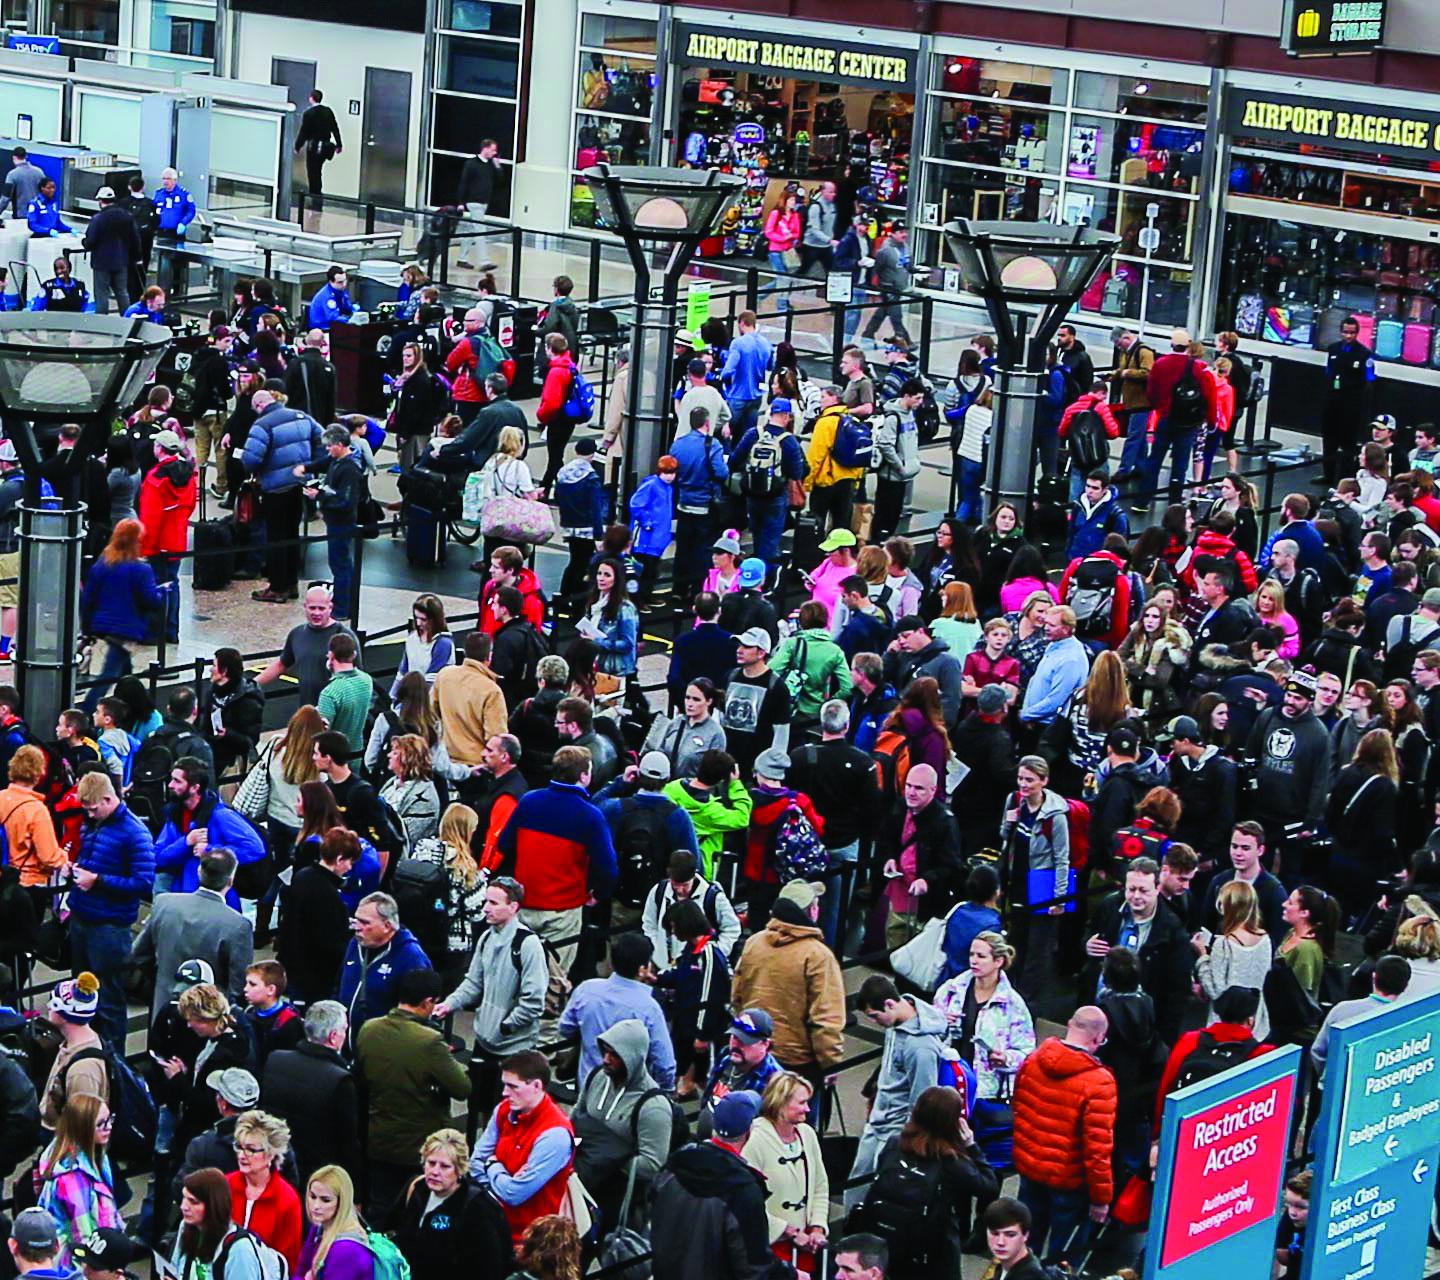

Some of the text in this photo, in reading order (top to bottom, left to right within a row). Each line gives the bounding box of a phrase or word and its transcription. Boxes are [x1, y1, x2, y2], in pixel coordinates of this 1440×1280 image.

[1329, 20, 1382, 42] STORAGE
[685, 32, 908, 84] AIRPORT BAGGAGE CENTER
[1242, 99, 1333, 139] AIRPORT
[1334, 109, 1430, 151] BAGGAGE
[1374, 1031, 1432, 1072] Disabled
[1364, 1055, 1435, 1097] Passengers
[1193, 1087, 1278, 1150] Restricted
[1392, 1092, 1401, 1108] &
[1348, 1099, 1440, 1147] Badged Employees
[1202, 1134, 1259, 1177] Access
[1187, 1195, 1255, 1238] Passengers Only
[1201, 1180, 1249, 1215] Authorized
[1326, 1196, 1397, 1240] Business Class
[1329, 1183, 1380, 1219] First Class
[1353, 1222, 1387, 1246] Passengers
